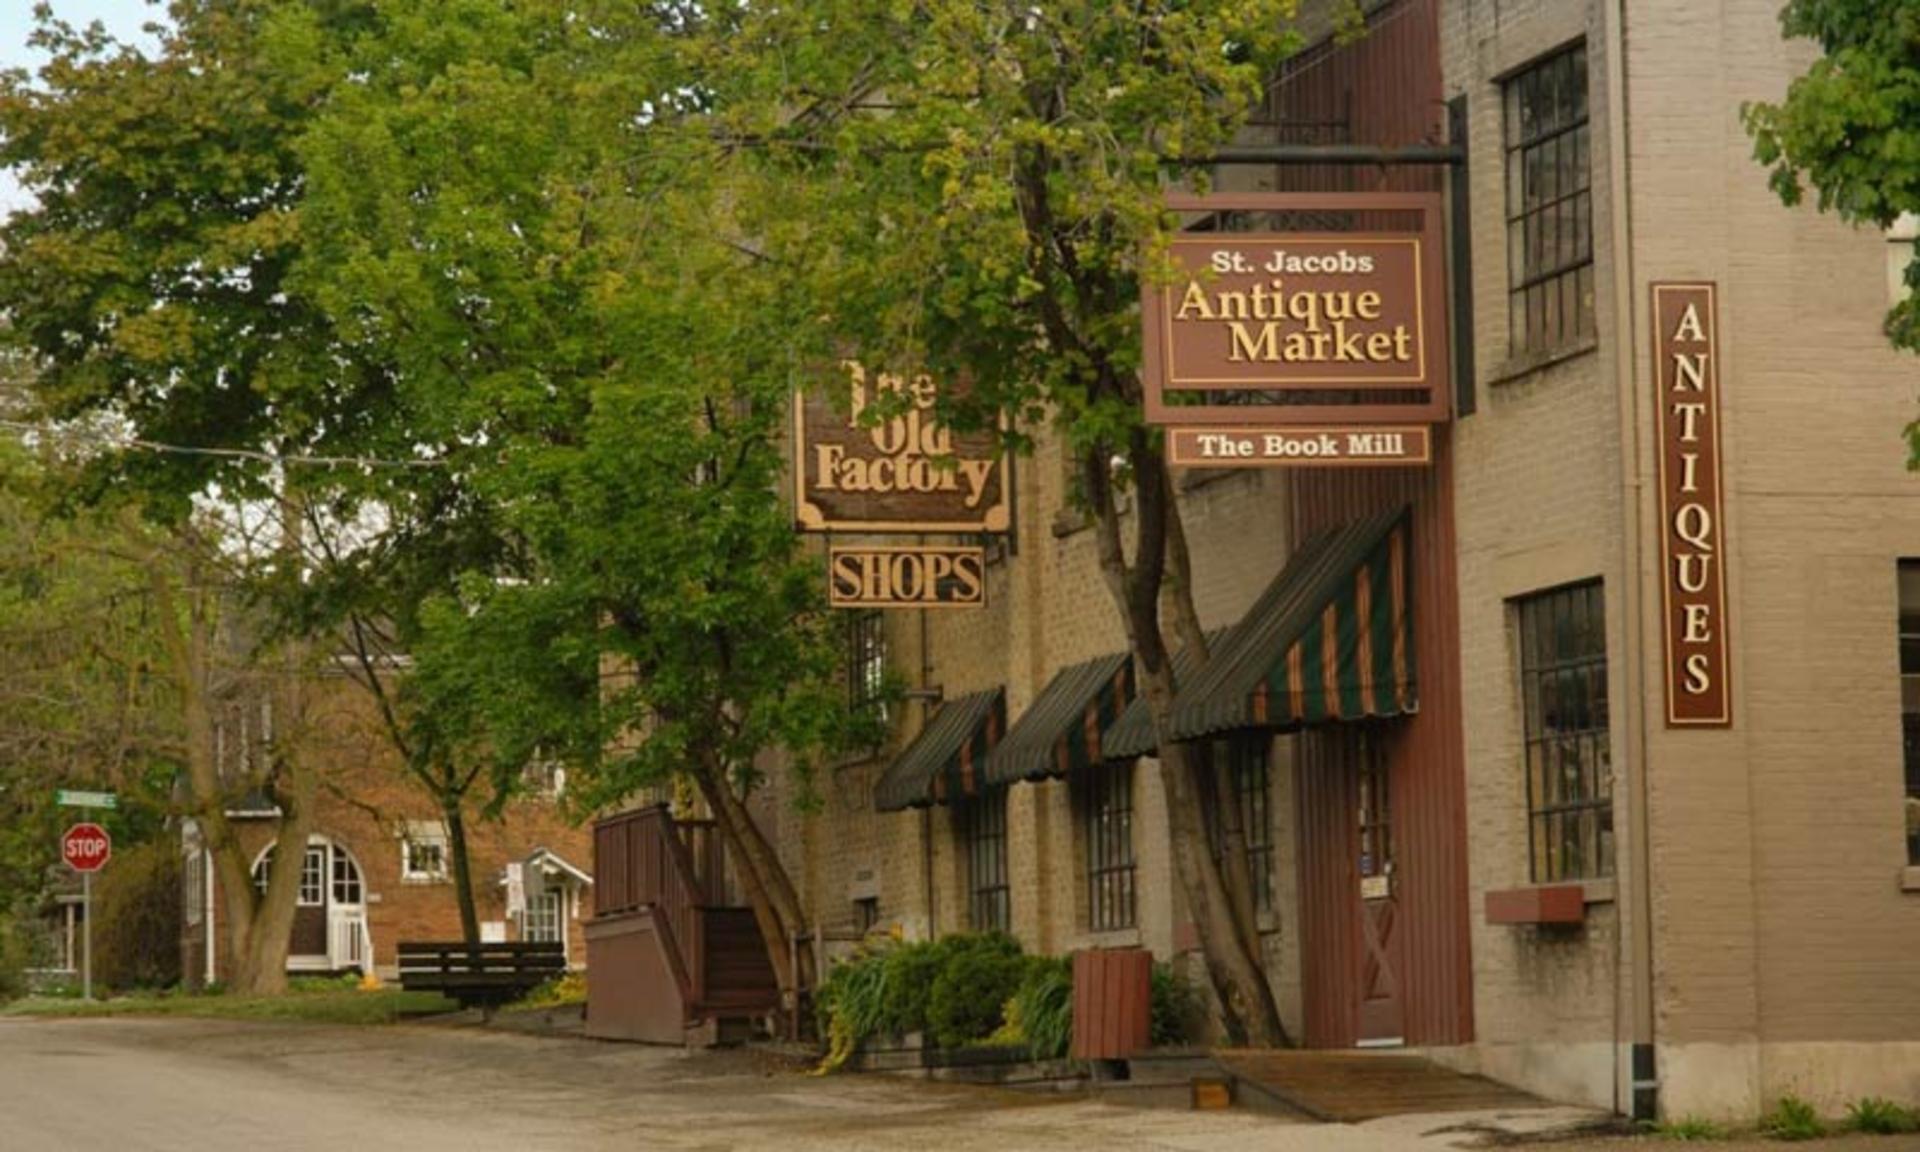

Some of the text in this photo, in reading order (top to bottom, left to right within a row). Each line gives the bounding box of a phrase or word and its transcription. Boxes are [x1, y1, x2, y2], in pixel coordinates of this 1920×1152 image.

[1211, 250, 1374, 273] St. Jacobs
[1175, 279, 1382, 332] Antique
[1228, 321, 1412, 362] Market
[1197, 434, 1405, 457] The Book Mill
[815, 443, 994, 508] Factory
[1673, 303, 1712, 694] ANTIQUES
[833, 553, 982, 601] SHOPS
[66, 839, 106, 858] STOP
